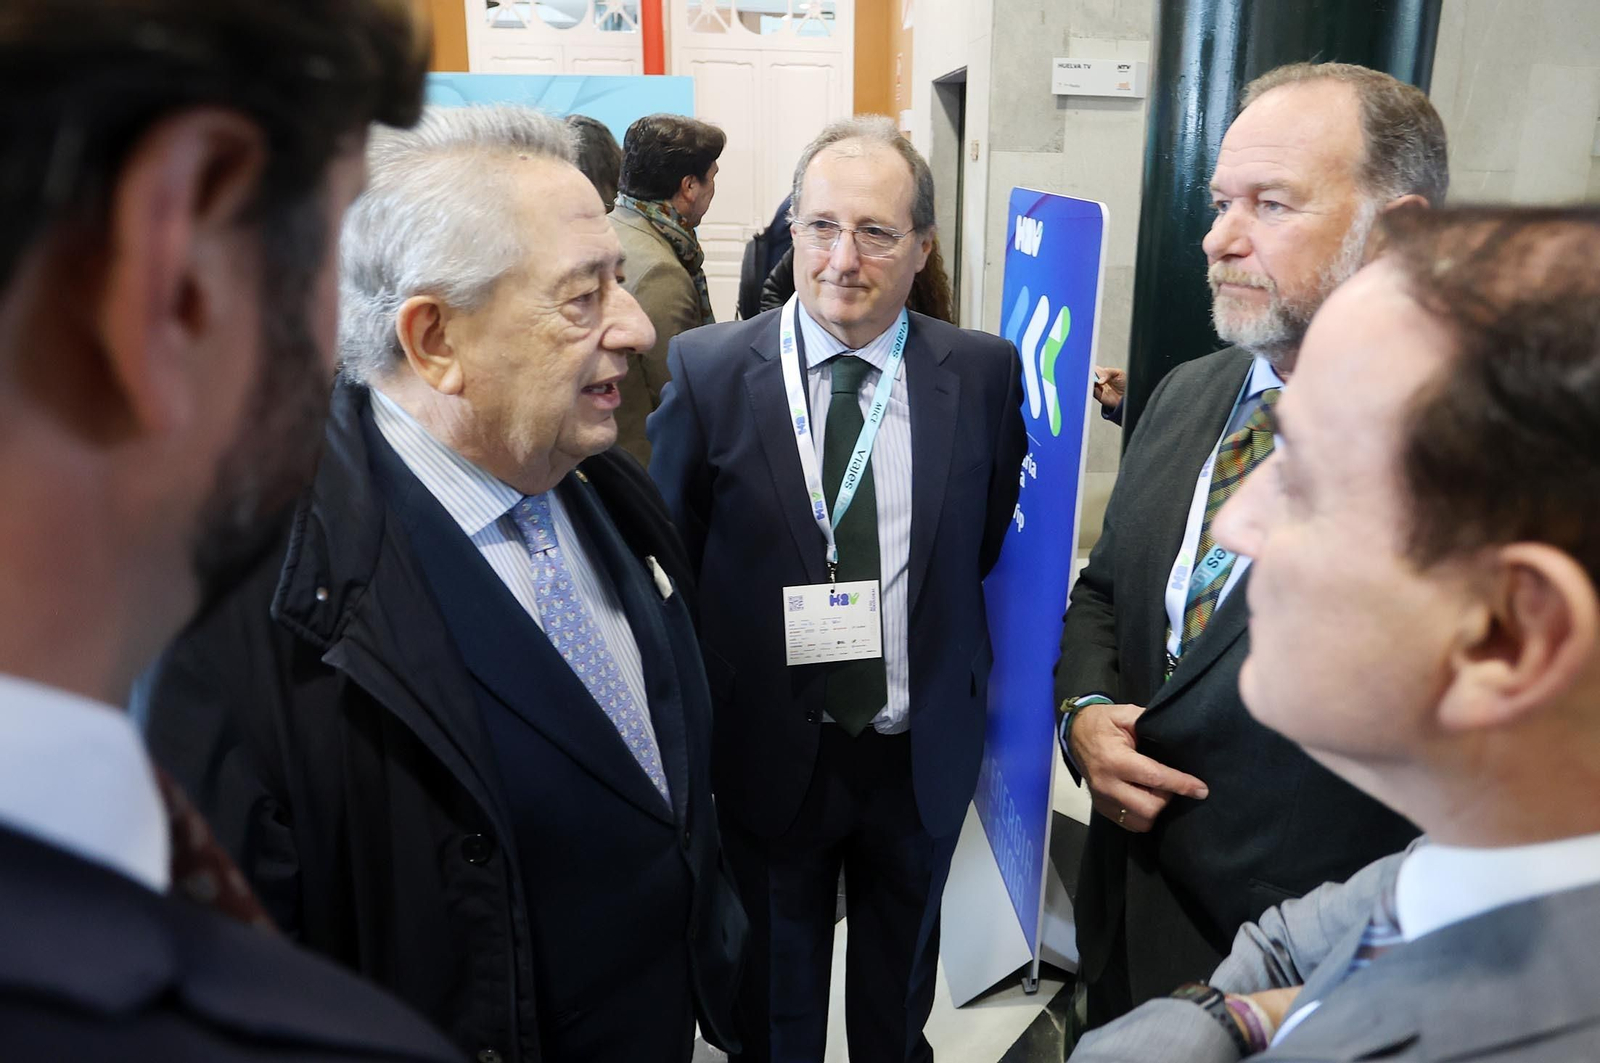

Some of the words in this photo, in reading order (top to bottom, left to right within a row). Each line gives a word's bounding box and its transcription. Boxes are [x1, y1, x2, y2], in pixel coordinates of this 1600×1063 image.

[892, 321, 907, 359] Viajes
[845, 450, 867, 490] Viajes
[829, 592, 860, 607] H2V
